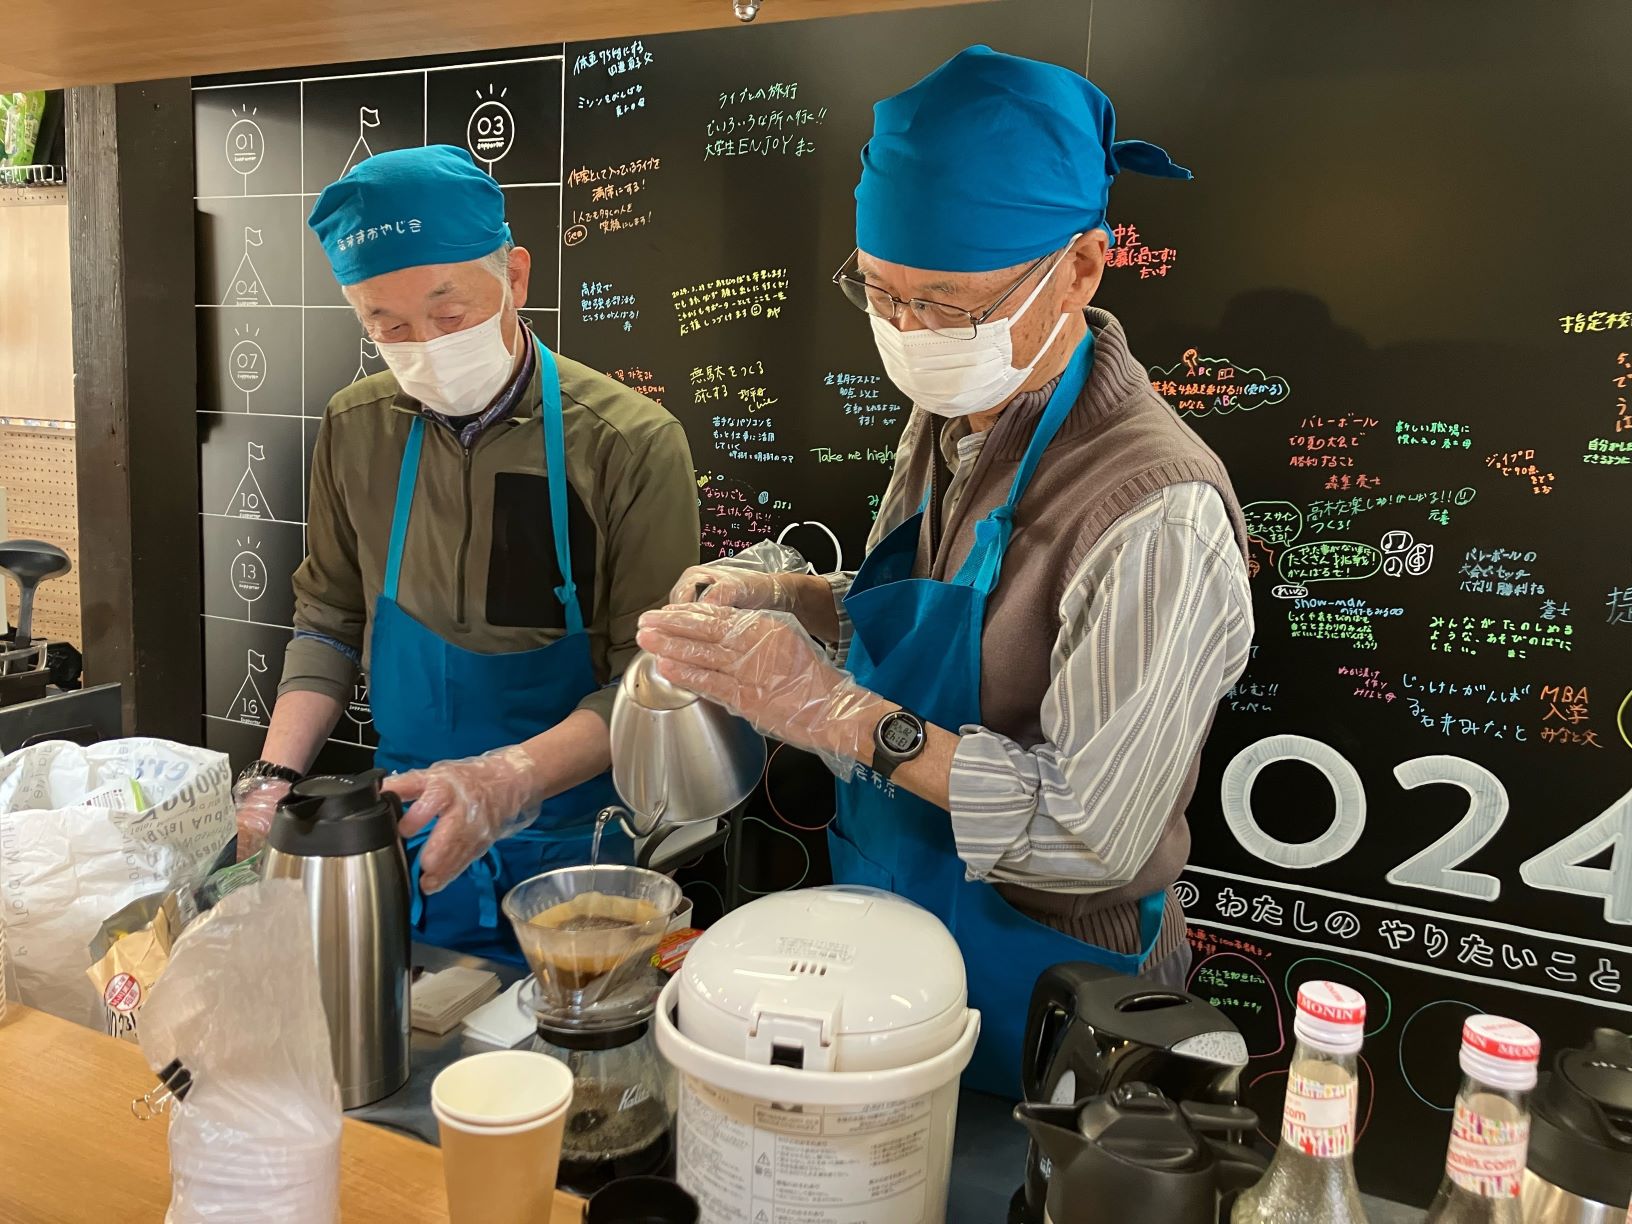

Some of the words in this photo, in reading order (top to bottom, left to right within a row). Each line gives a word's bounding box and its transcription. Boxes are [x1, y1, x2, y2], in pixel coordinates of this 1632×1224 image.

[477, 116, 504, 135] 03
[235, 134, 253, 150] 01
[1113, 223, 1142, 247] 中を
[235, 280, 259, 295] 04
[580, 281, 613, 297] 高校で
[237, 353, 258, 369] 07
[689, 360, 765, 386] 無駄をつくる
[712, 415, 773, 428] 苦手なパソコンを
[1300, 412, 1380, 429] バレーボール
[809, 447, 844, 464] Take
[848, 451, 862, 460] me
[240, 493, 259, 509] 10
[702, 486, 748, 502] ならいごと
[1465, 547, 1538, 563] バレーボールの
[240, 563, 257, 580] 13
[1429, 616, 1574, 636] みんながたのしめる
[353, 684, 368, 702] 17
[1539, 684, 1590, 704] MBA
[242, 697, 258, 715] 16
[1541, 702, 1590, 725] 入学
[1215, 886, 1362, 940] わたしの
[1377, 918, 1624, 994] やりたいこと
[1300, 996, 1354, 1021] MONIN
